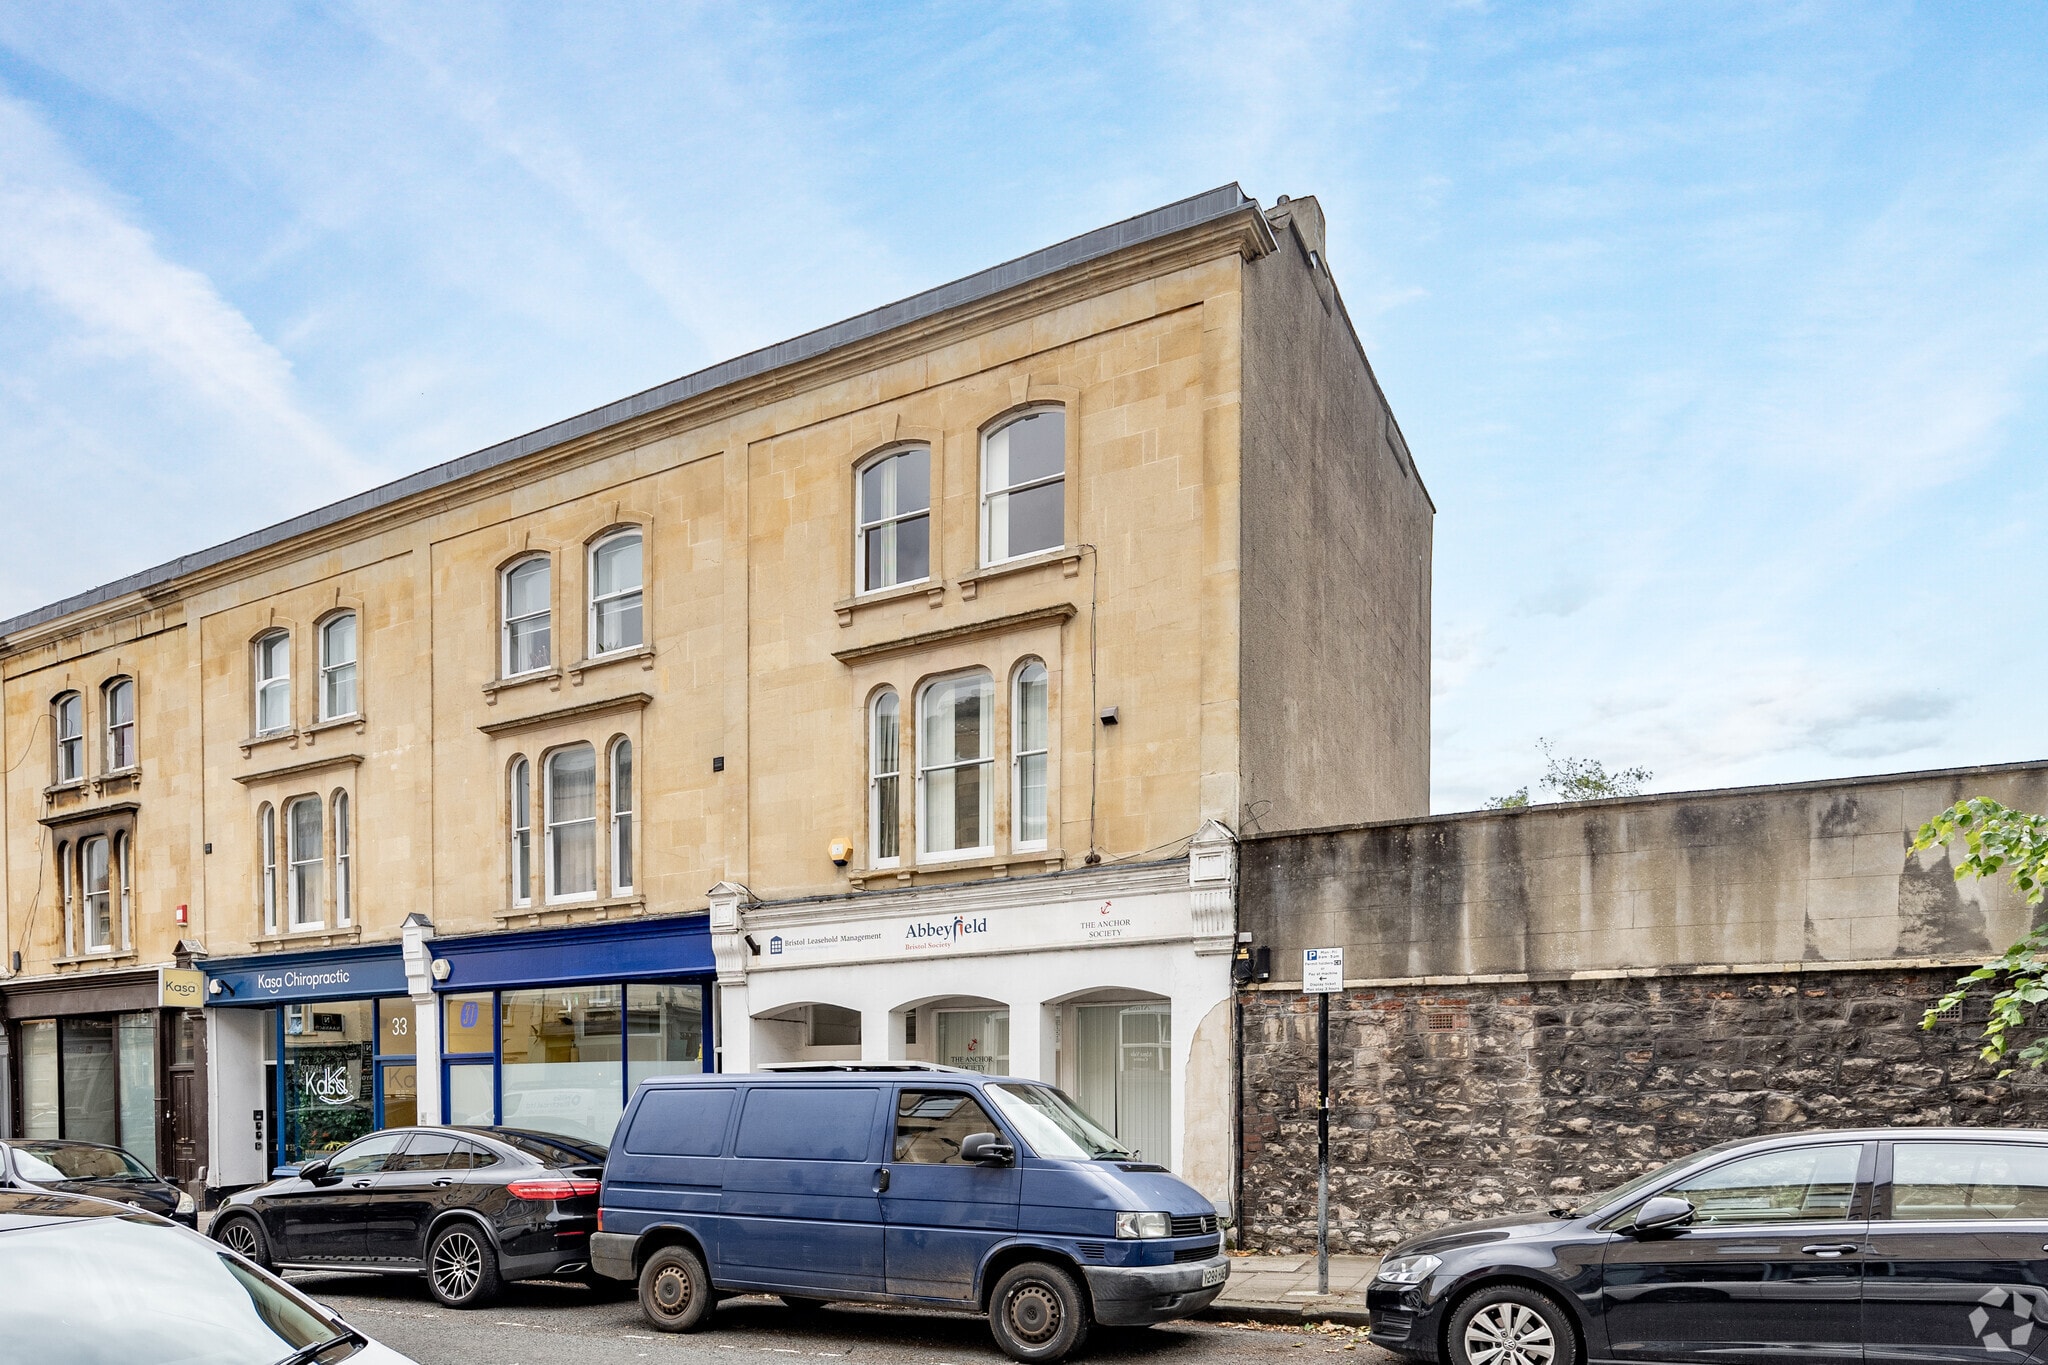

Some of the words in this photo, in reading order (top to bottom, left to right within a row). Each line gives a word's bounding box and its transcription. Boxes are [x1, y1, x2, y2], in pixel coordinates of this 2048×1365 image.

[905, 916, 987, 943] Abbeyfield
[1098, 919, 1131, 928] ANCHOR
[1089, 929, 1121, 938] SOCIETY
[785, 939, 805, 947] Bristol
[807, 936, 838, 944] Leasehold
[840, 933, 881, 942] Management
[928, 941, 951, 949] Society
[1309, 951, 1316, 960] P
[258, 974, 282, 989] Kasa
[285, 969, 350, 989] Chiropractic
[166, 981, 196, 993] Kasa
[392, 1017, 407, 1035] 33
